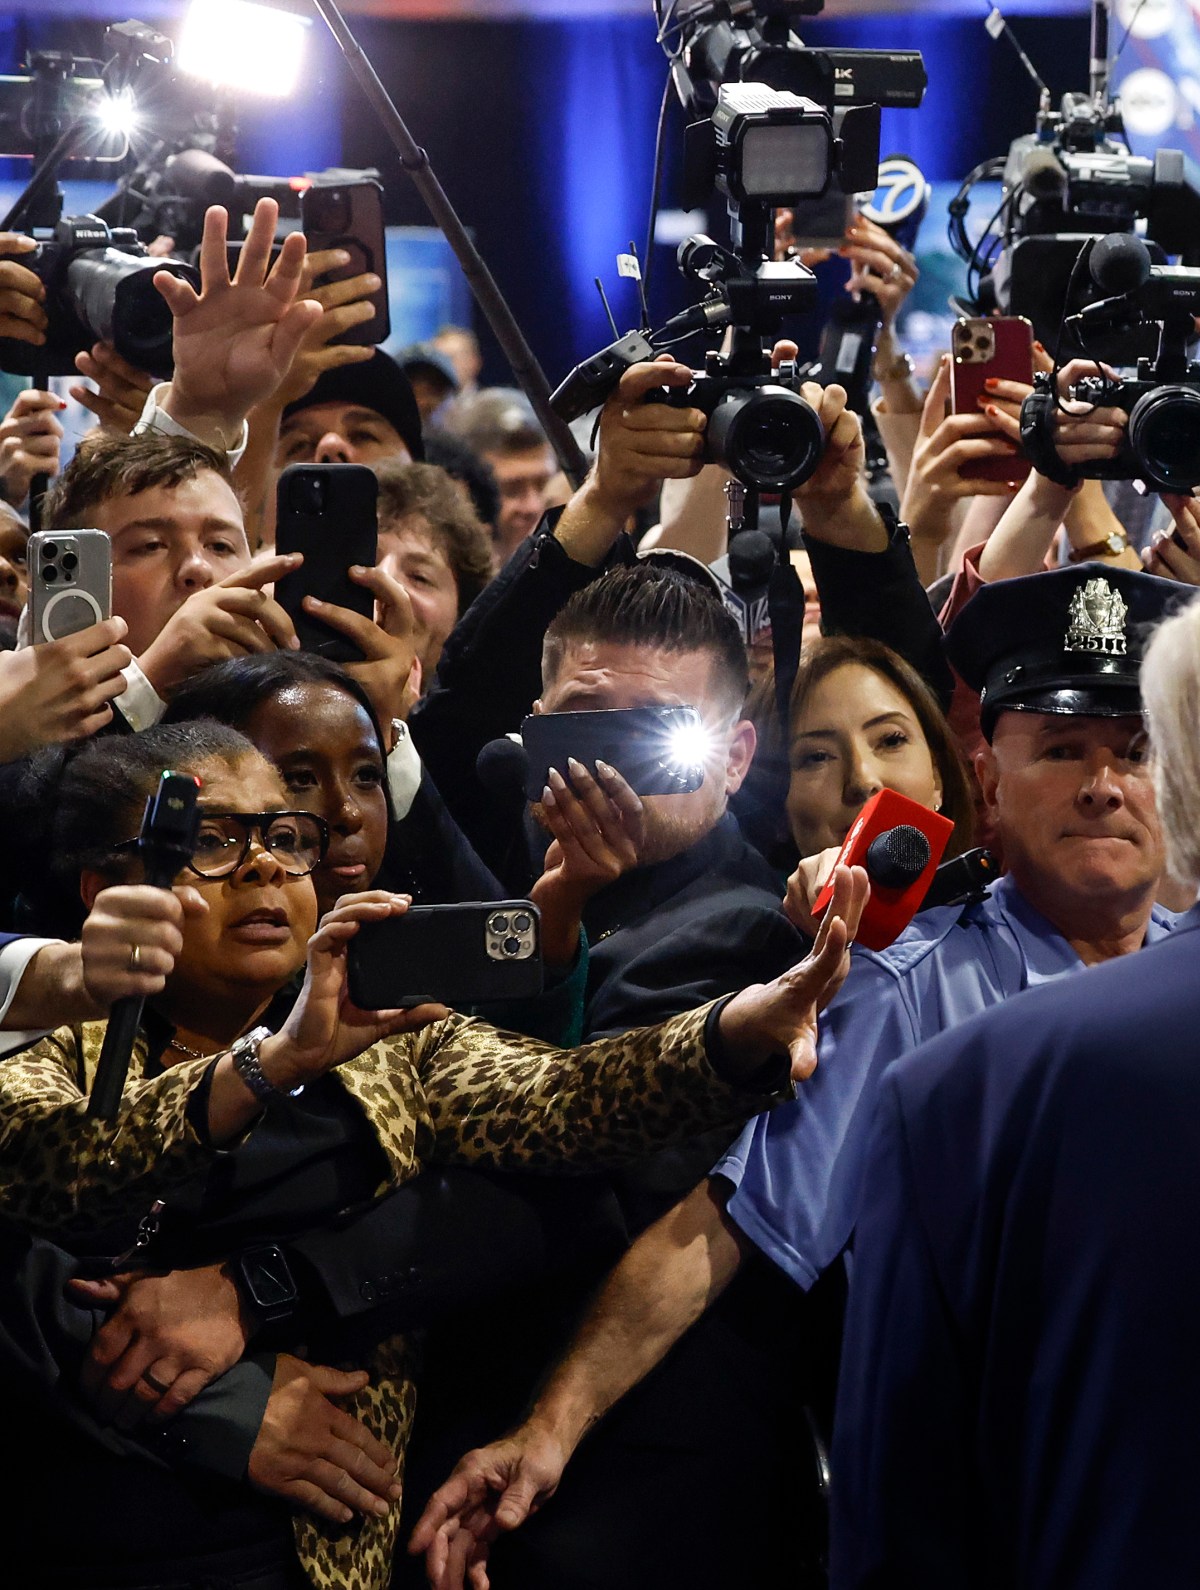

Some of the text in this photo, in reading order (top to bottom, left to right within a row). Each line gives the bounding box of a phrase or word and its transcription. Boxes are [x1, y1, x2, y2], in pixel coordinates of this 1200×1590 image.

[76, 229, 107, 238] Nikon
[1173, 289, 1197, 297] SONY
[1071, 634, 1119, 655] 2511
